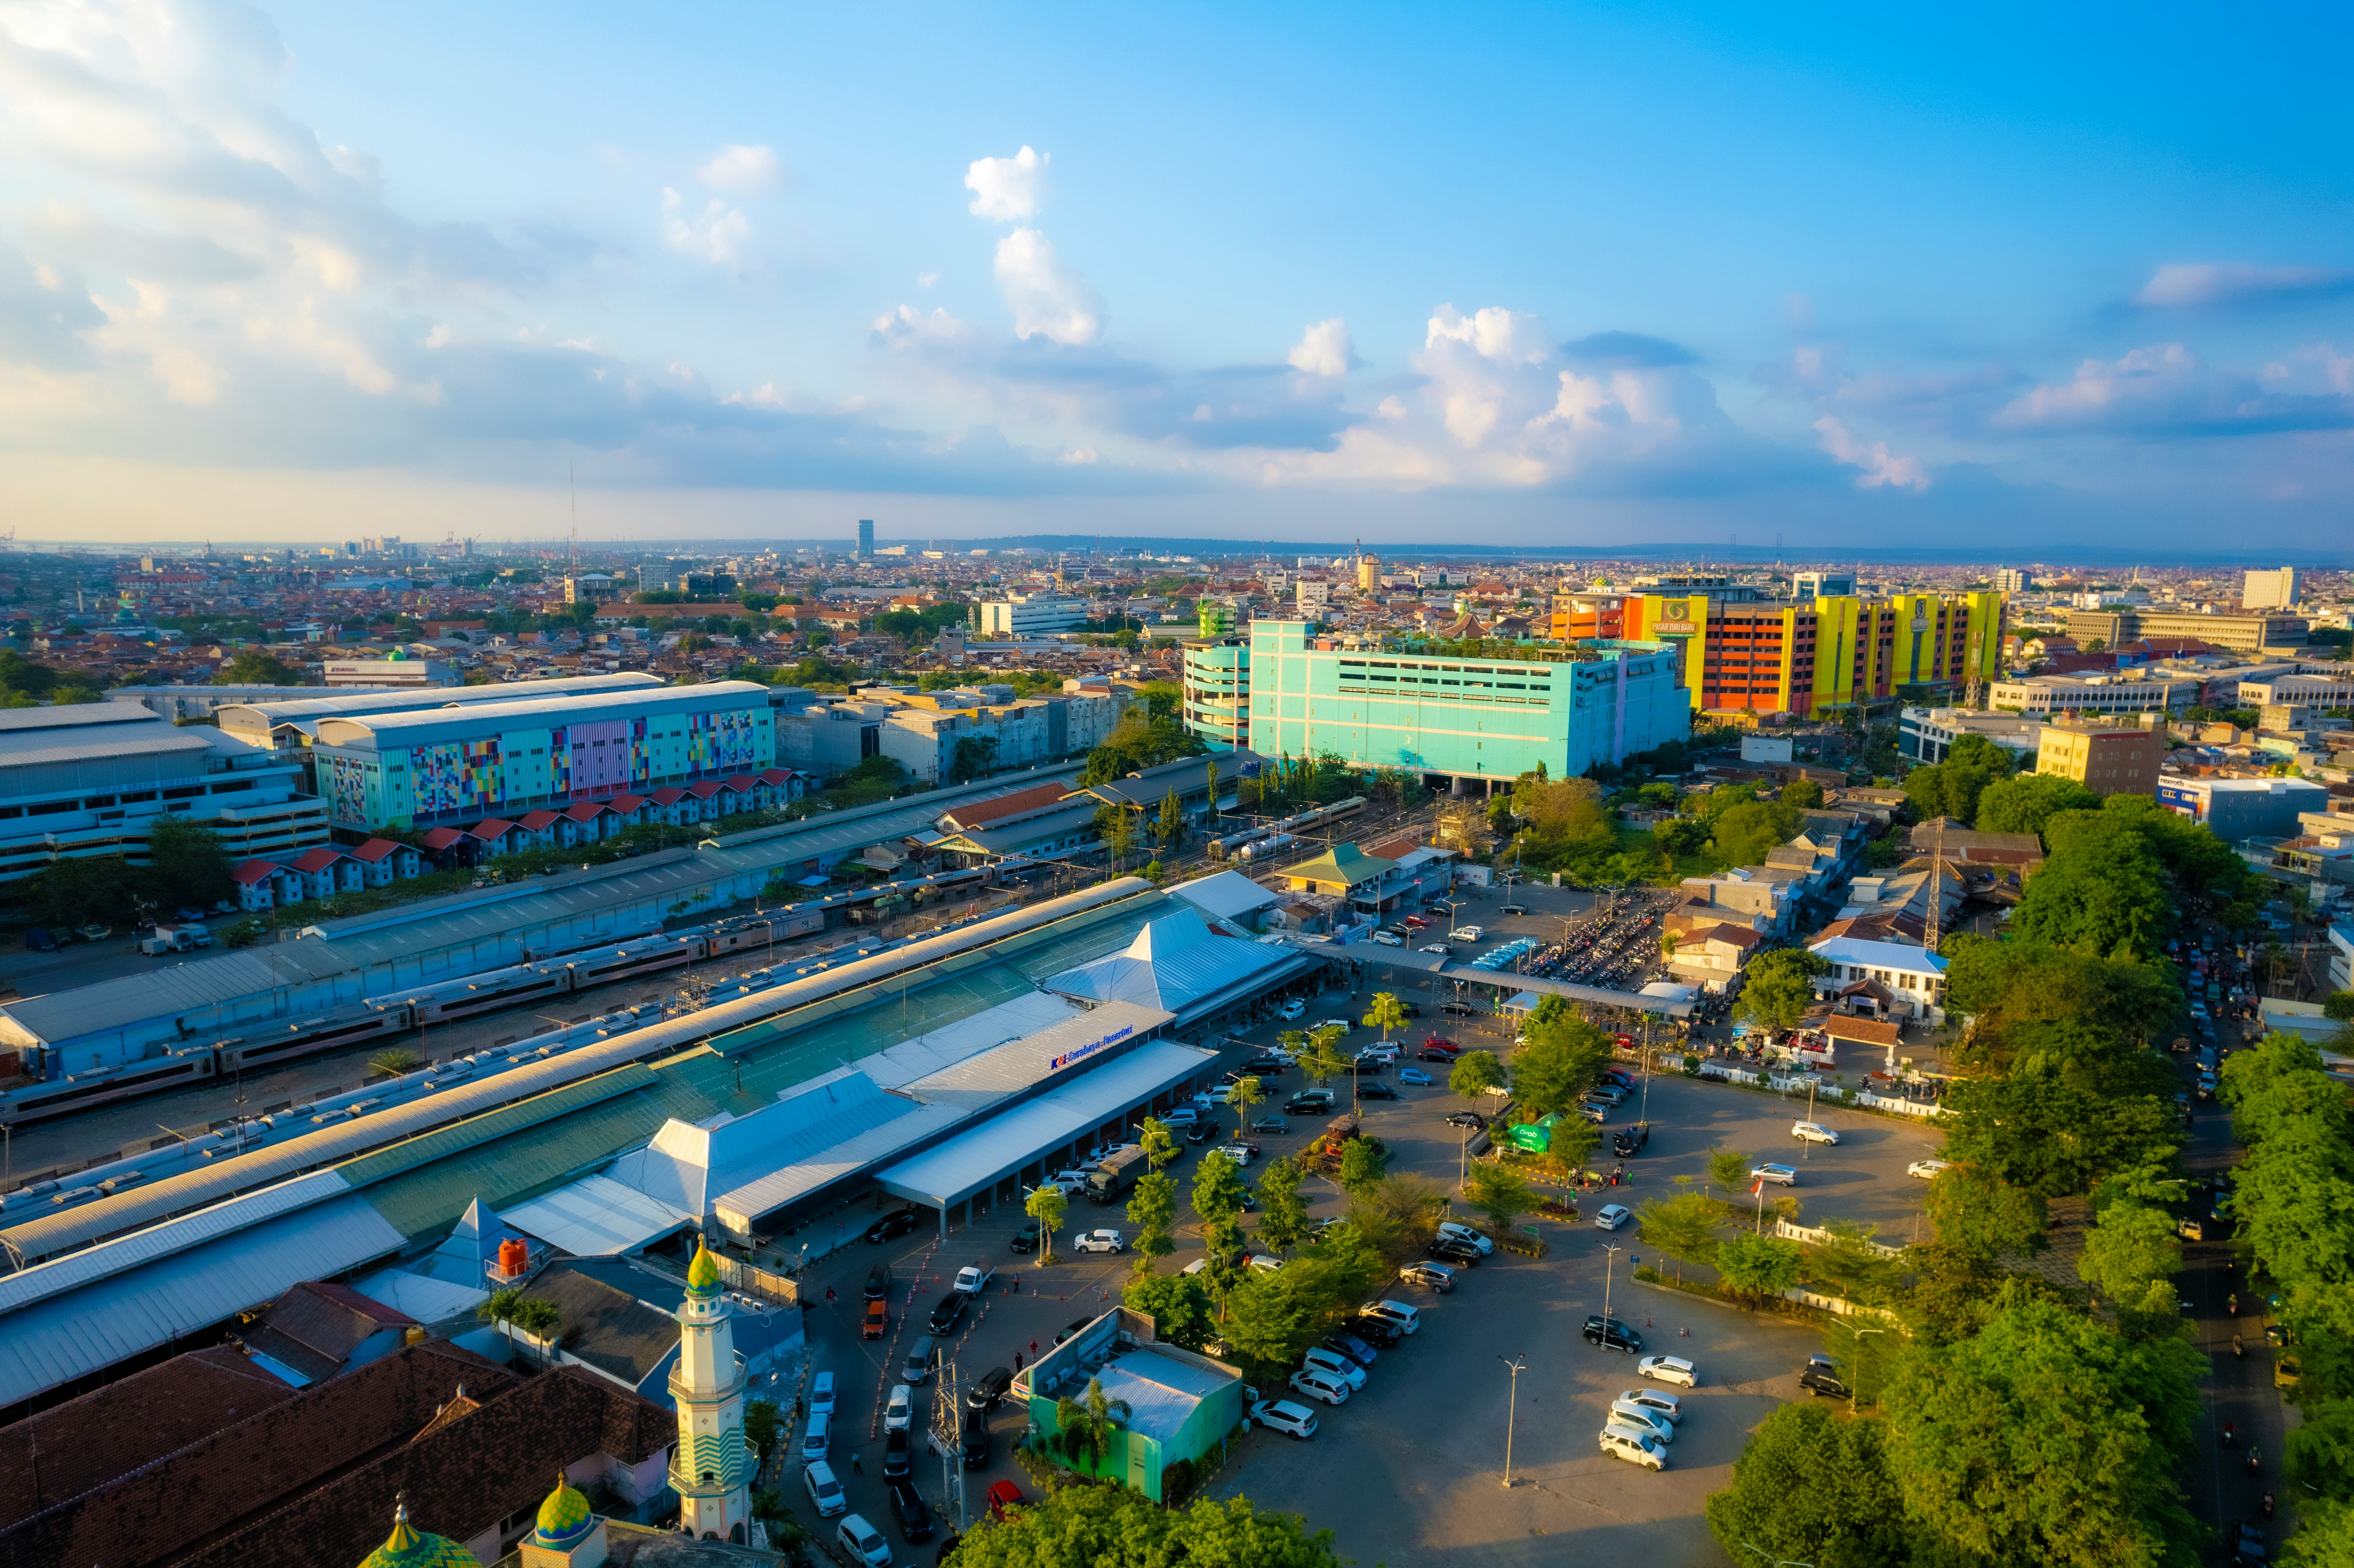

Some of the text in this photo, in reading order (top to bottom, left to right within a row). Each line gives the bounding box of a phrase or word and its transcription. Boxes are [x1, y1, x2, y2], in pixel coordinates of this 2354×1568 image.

[160, 777, 201, 787] SURABAYA
[2161, 778, 2184, 787] rexroth
[1051, 1024, 1133, 1070] KAI Surabaya Pasarturi
[1520, 1129, 1537, 1137] Grab
